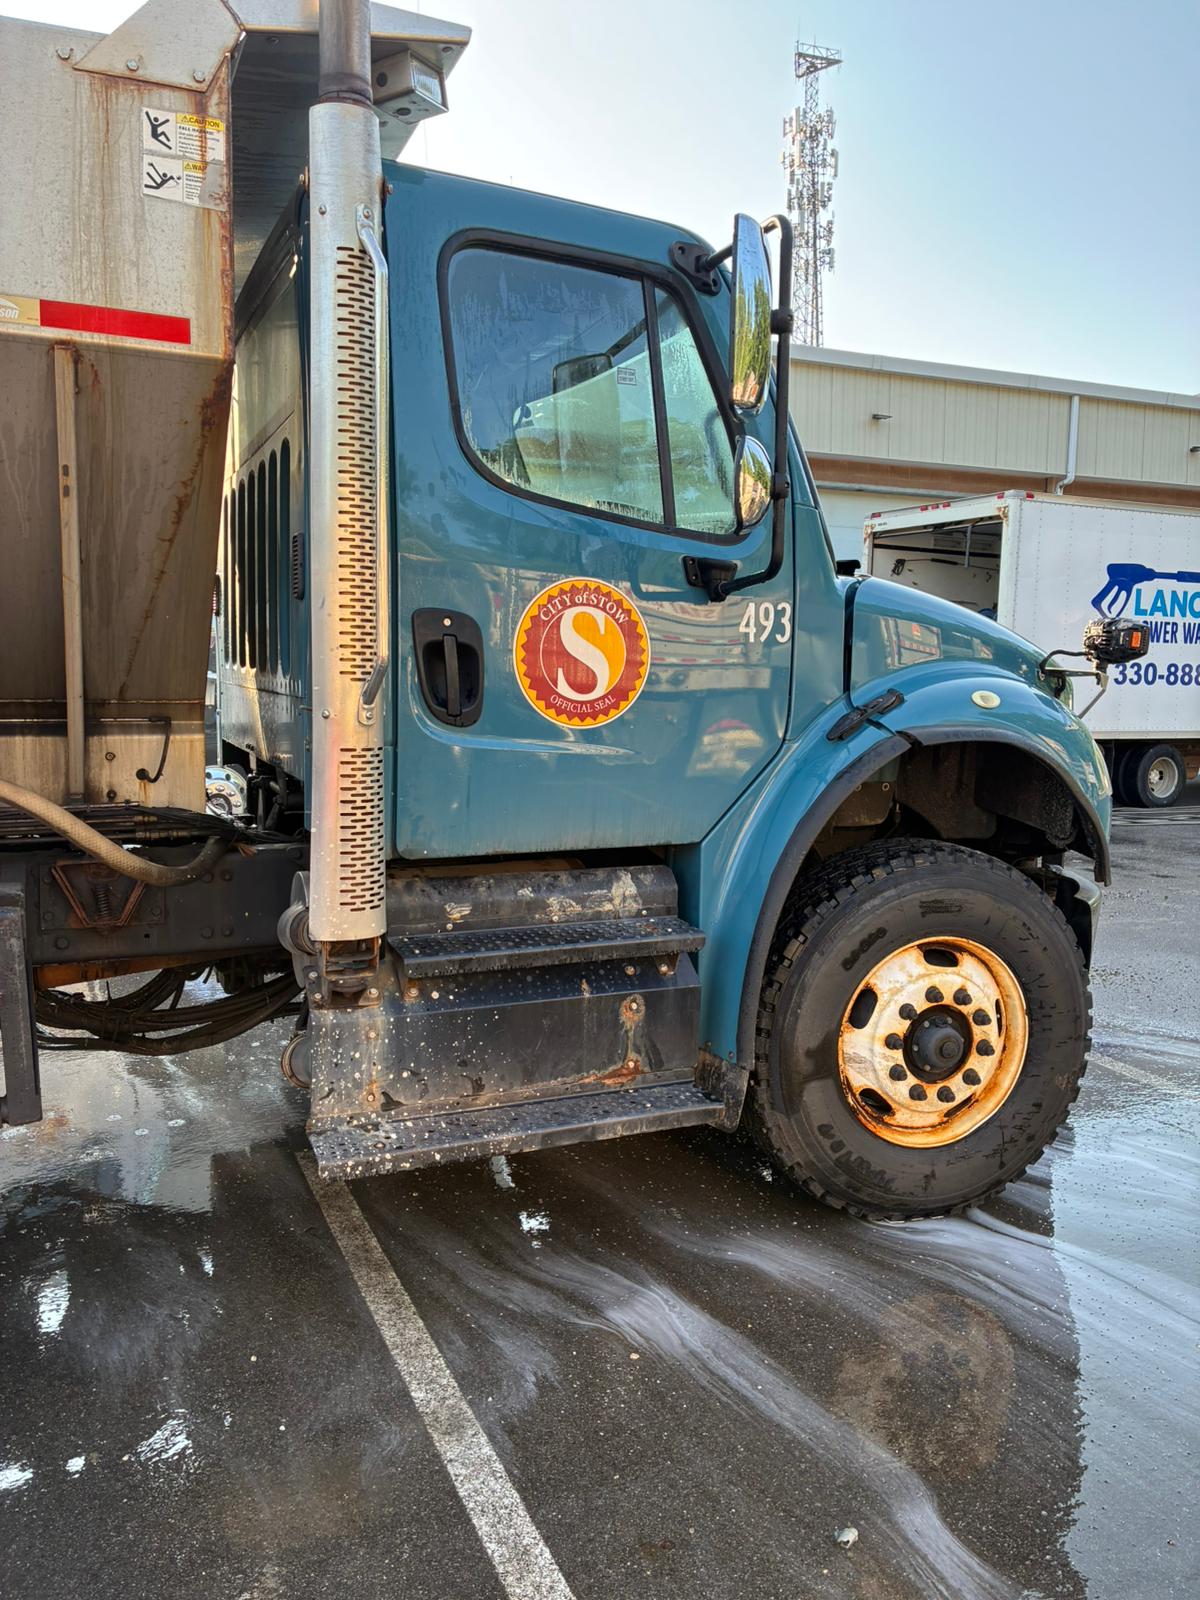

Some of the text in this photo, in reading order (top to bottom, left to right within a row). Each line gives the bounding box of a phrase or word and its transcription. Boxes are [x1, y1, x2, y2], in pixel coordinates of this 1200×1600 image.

[188, 116, 220, 128] CAUTION
[540, 591, 629, 624] CITY of STOW
[739, 602, 792, 643] 493
[1142, 620, 1178, 644] WER
[557, 606, 610, 701] S
[550, 694, 617, 713] OFFICIAL SEAL
